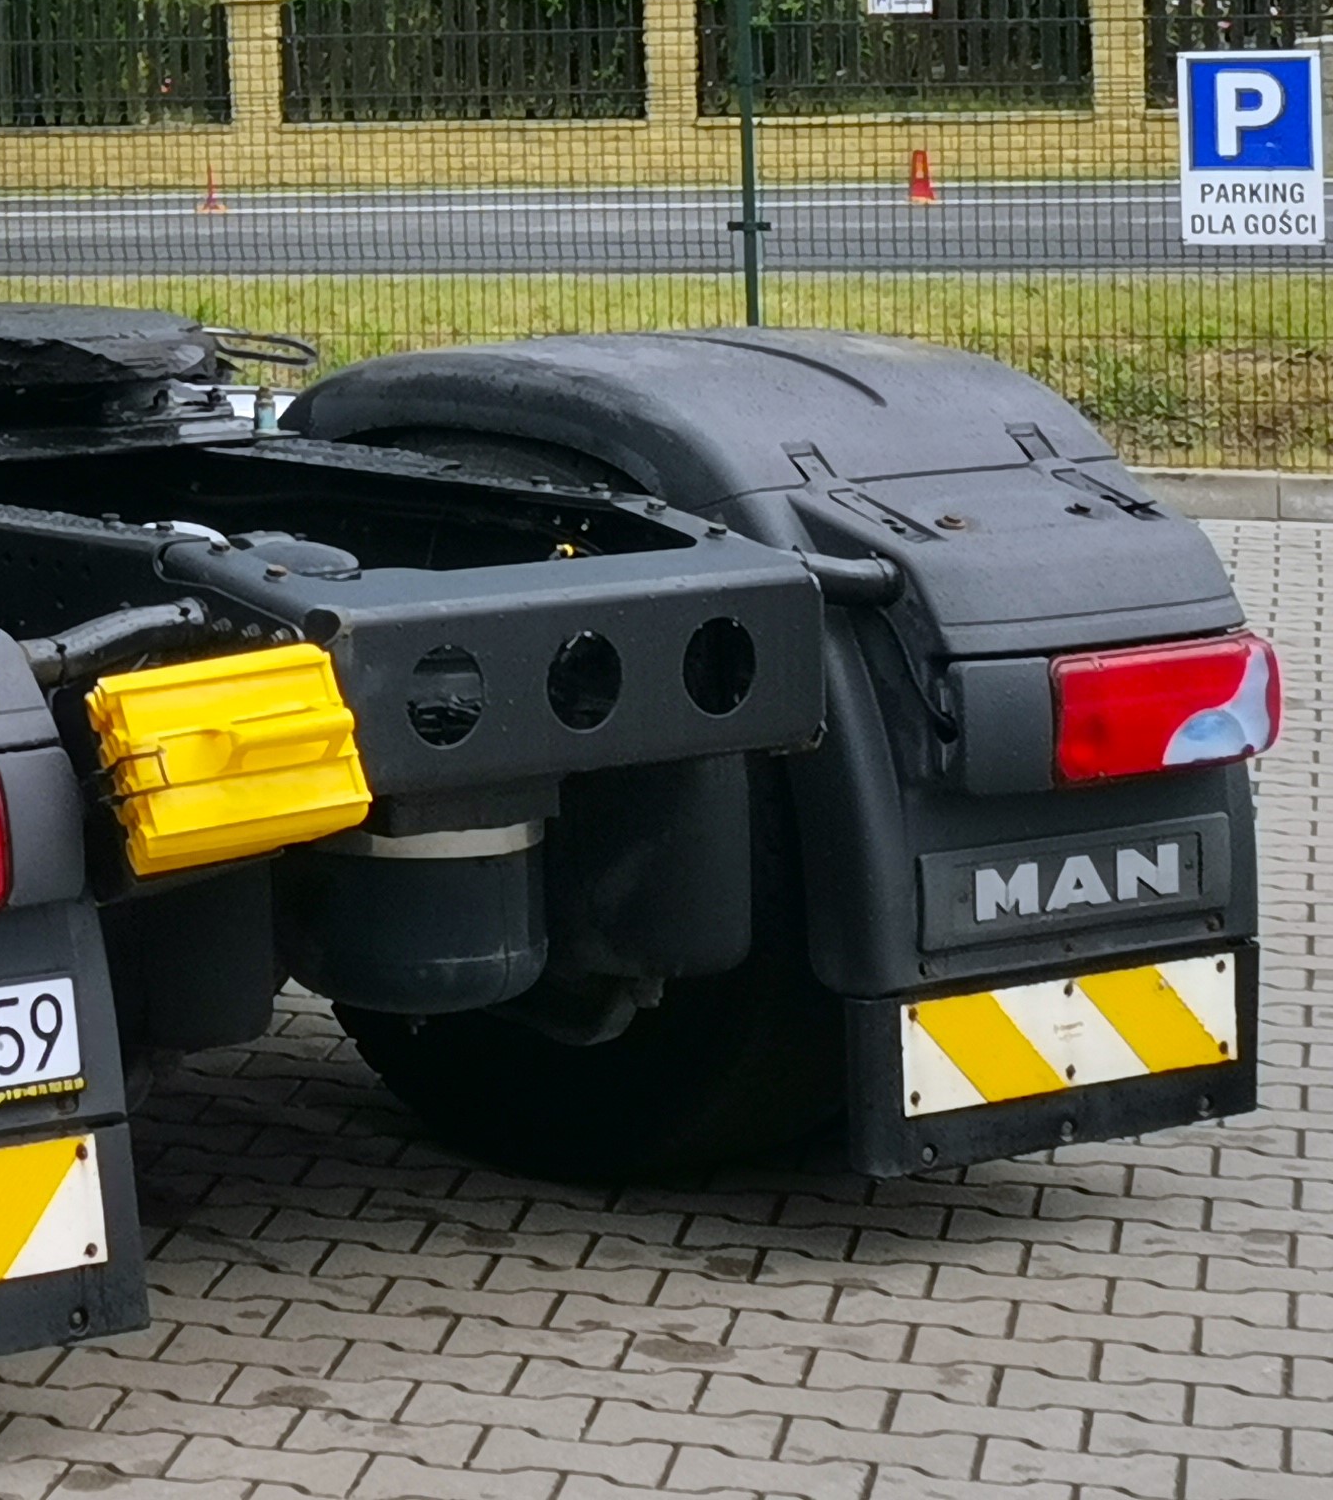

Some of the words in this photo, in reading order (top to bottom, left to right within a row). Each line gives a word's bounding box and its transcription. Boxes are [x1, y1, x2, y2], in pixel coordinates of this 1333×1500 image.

[1215, 70, 1284, 157] P
[1200, 182, 1305, 204] PARKING
[1190, 214, 1236, 235] DLA
[1244, 209, 1317, 235] GOŚCI
[974, 842, 1180, 923] MAN
